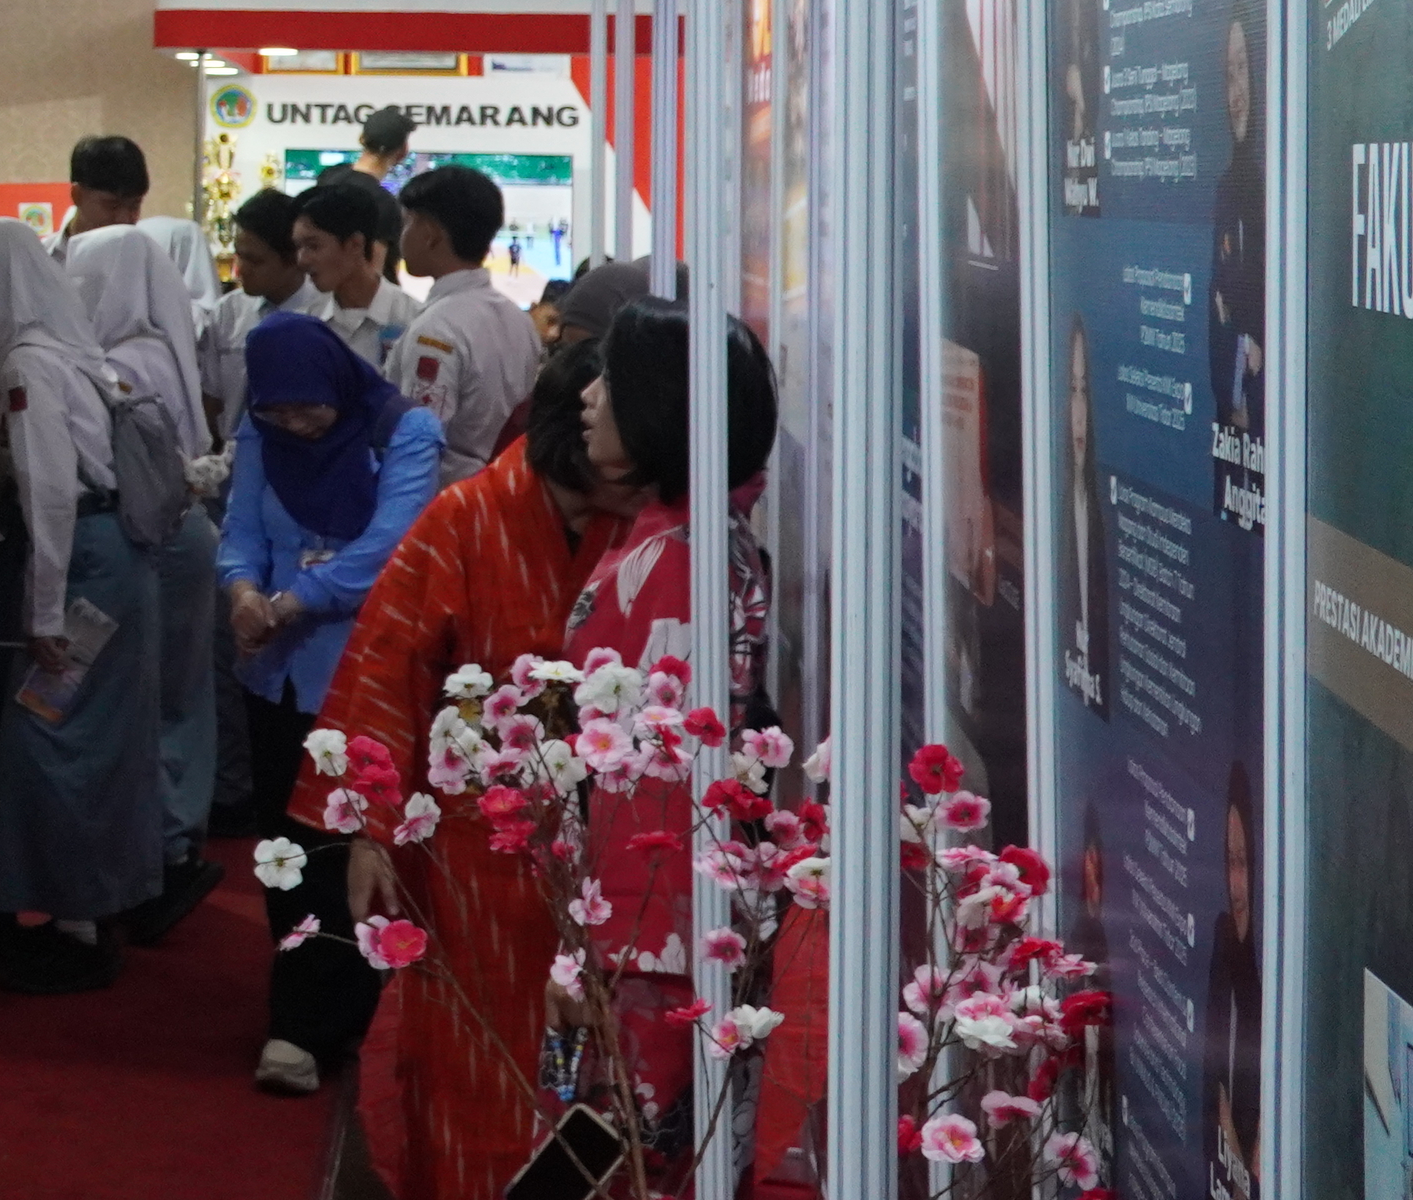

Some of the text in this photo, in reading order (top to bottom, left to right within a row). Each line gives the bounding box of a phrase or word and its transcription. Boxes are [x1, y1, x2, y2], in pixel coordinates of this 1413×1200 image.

[267, 103, 374, 125] UNTAG
[1211, 422, 1242, 466] Zakia
[1313, 579, 1361, 645] PRESTASI
